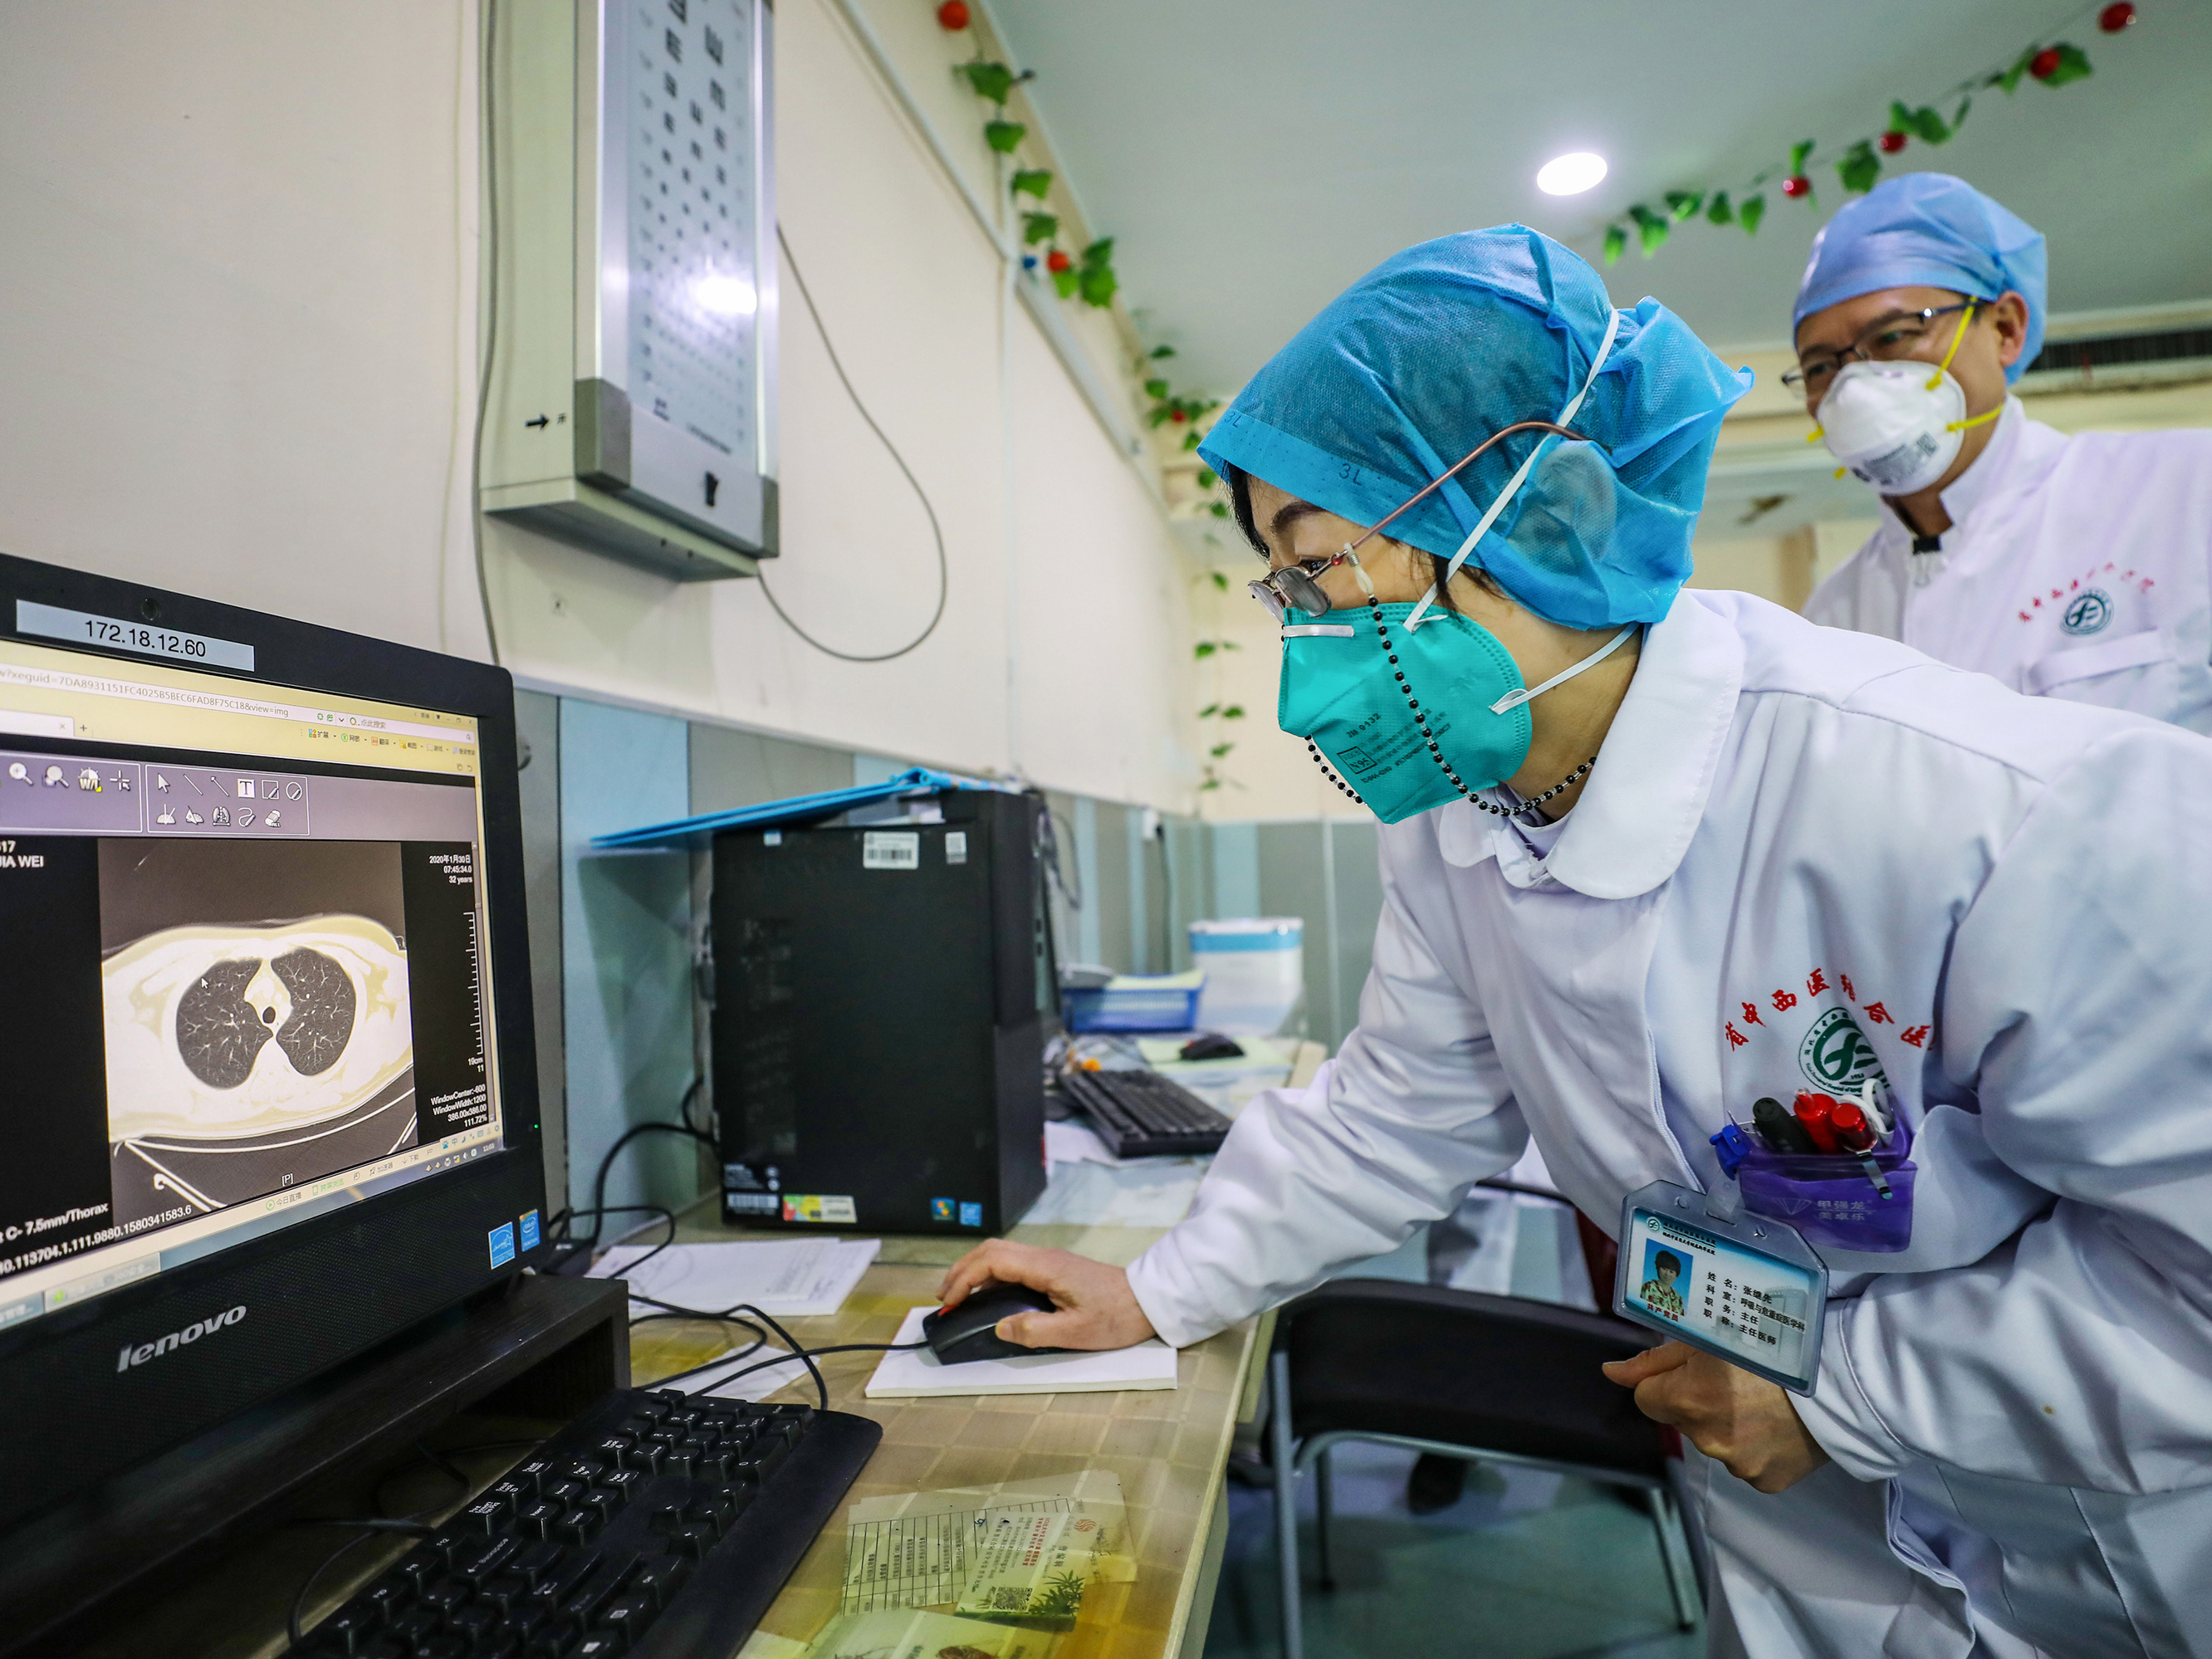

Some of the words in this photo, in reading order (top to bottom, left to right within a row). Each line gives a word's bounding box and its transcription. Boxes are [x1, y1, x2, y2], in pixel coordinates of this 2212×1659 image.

[1224, 412, 1242, 428] 3L
[1338, 463, 1362, 486] 3L
[85, 620, 206, 657] 172.18.12.60
[1358, 712, 1382, 731] 9132
[17, 855, 44, 868] WEI
[429, 854, 471, 864] 2020年1月30日
[448, 875, 457, 883] 32
[457, 877, 472, 885] years
[431, 1084, 486, 1105] WindowCenter:-600
[433, 1094, 487, 1115] WindowWidth:1200
[464, 1114, 487, 1127] 111.72%
[25, 1202, 110, 1236] 7.5mm/Thorax
[1743, 1285, 1773, 1304] 张继先
[1647, 1303, 1679, 1323] 共产党员
[1740, 1297, 1806, 1332] 呼吸与危重症医学科
[1740, 1311, 1759, 1325] 主任
[117, 1305, 247, 1373] lenovo
[1739, 1324, 1777, 1345] 主任医师
